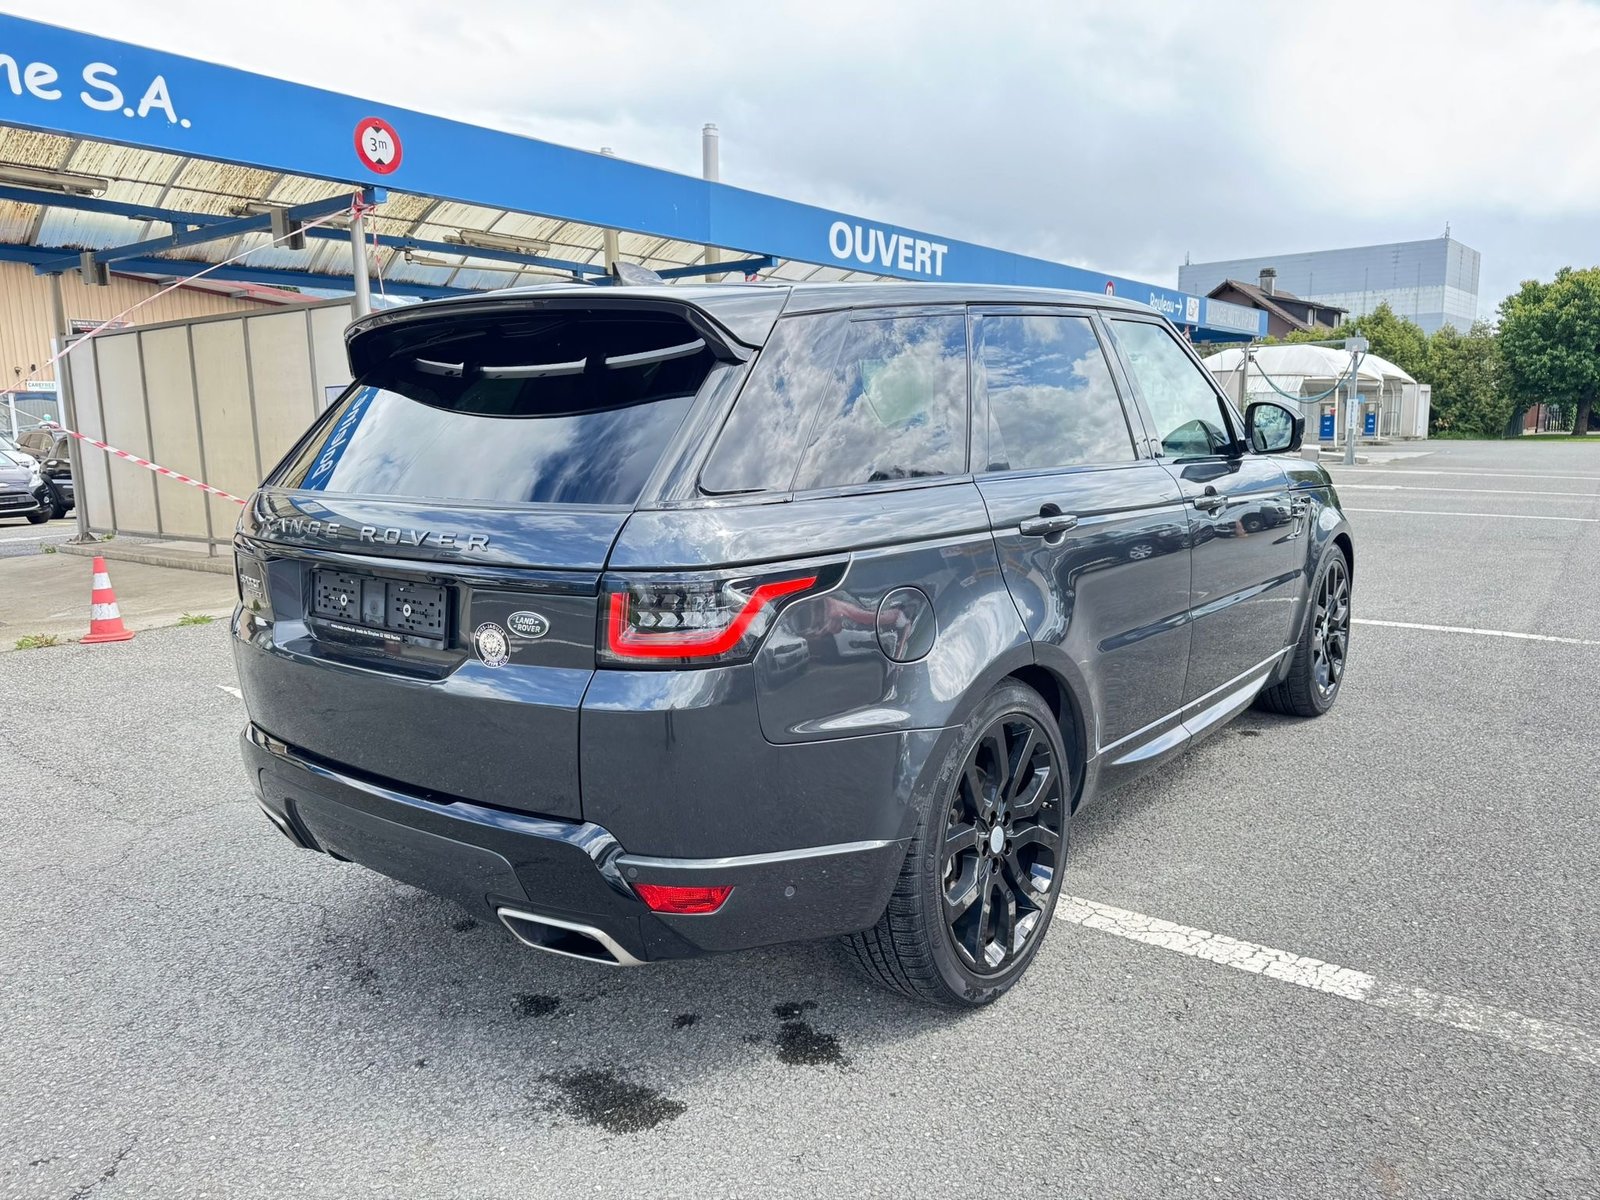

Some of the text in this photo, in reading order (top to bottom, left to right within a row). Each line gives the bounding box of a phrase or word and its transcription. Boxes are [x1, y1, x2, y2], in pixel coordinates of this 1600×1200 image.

[80, 61, 192, 129] S.A.
[828, 220, 949, 277] OUVERT
[259, 515, 491, 552] RANGE ROVER
[515, 615, 541, 633] LAND ROVER
